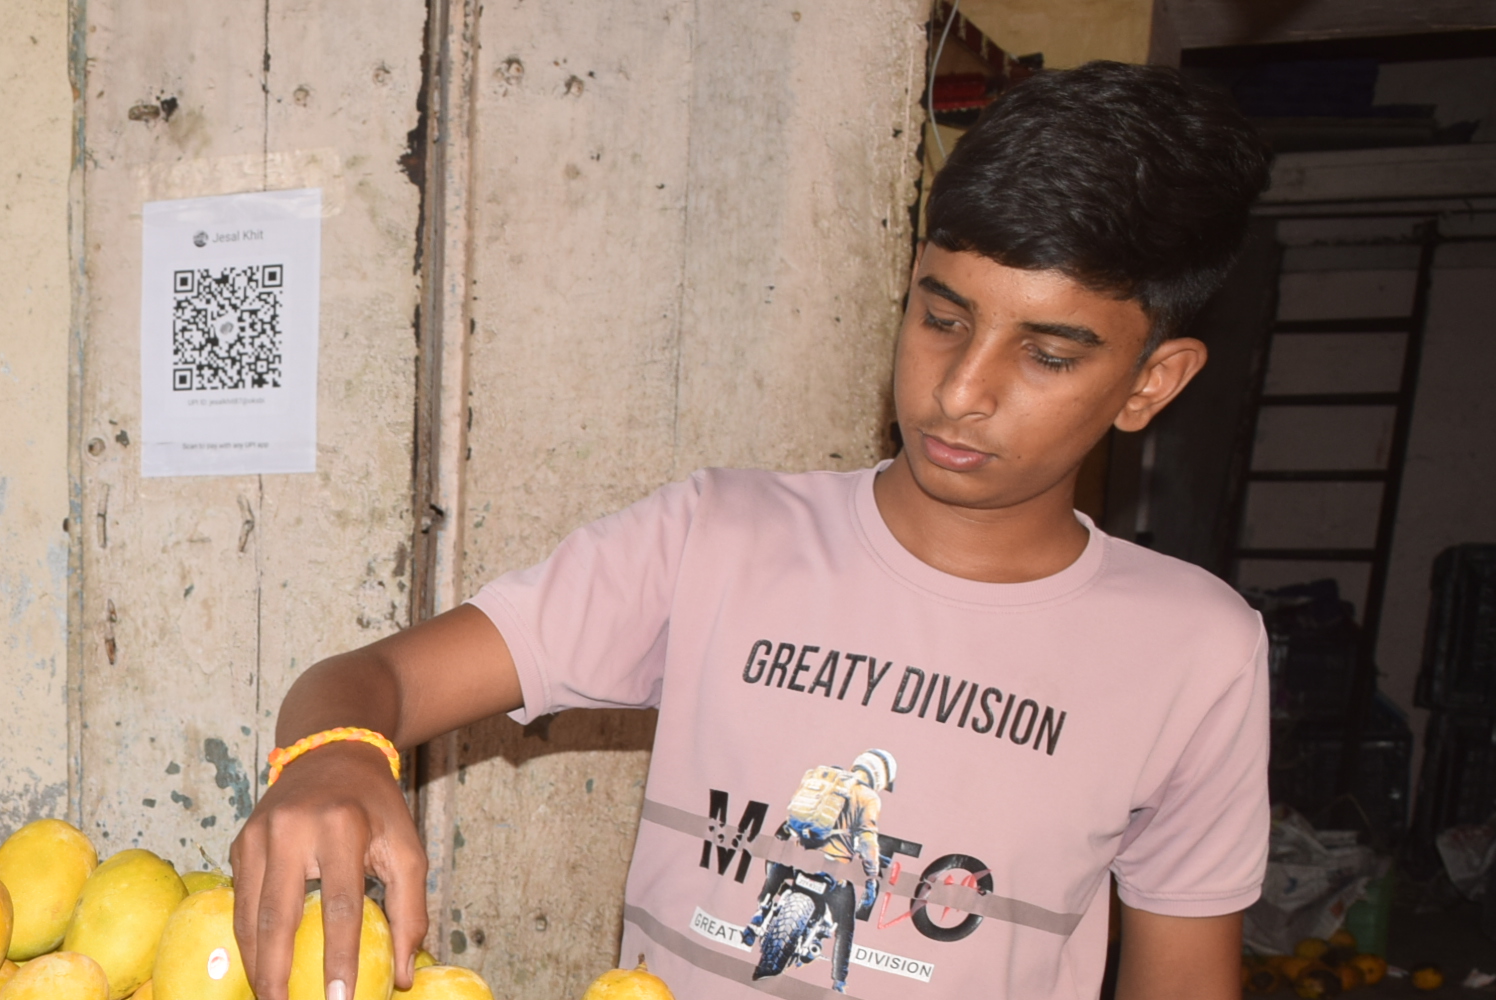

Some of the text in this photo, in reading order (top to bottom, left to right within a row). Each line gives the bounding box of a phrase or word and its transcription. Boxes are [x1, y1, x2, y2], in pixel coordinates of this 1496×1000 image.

[212, 230, 240, 243] Jesal
[741, 638, 1068, 758] GREATY DIVISION
[699, 788, 994, 943] MTO
[855, 947, 933, 978] DIVISION
